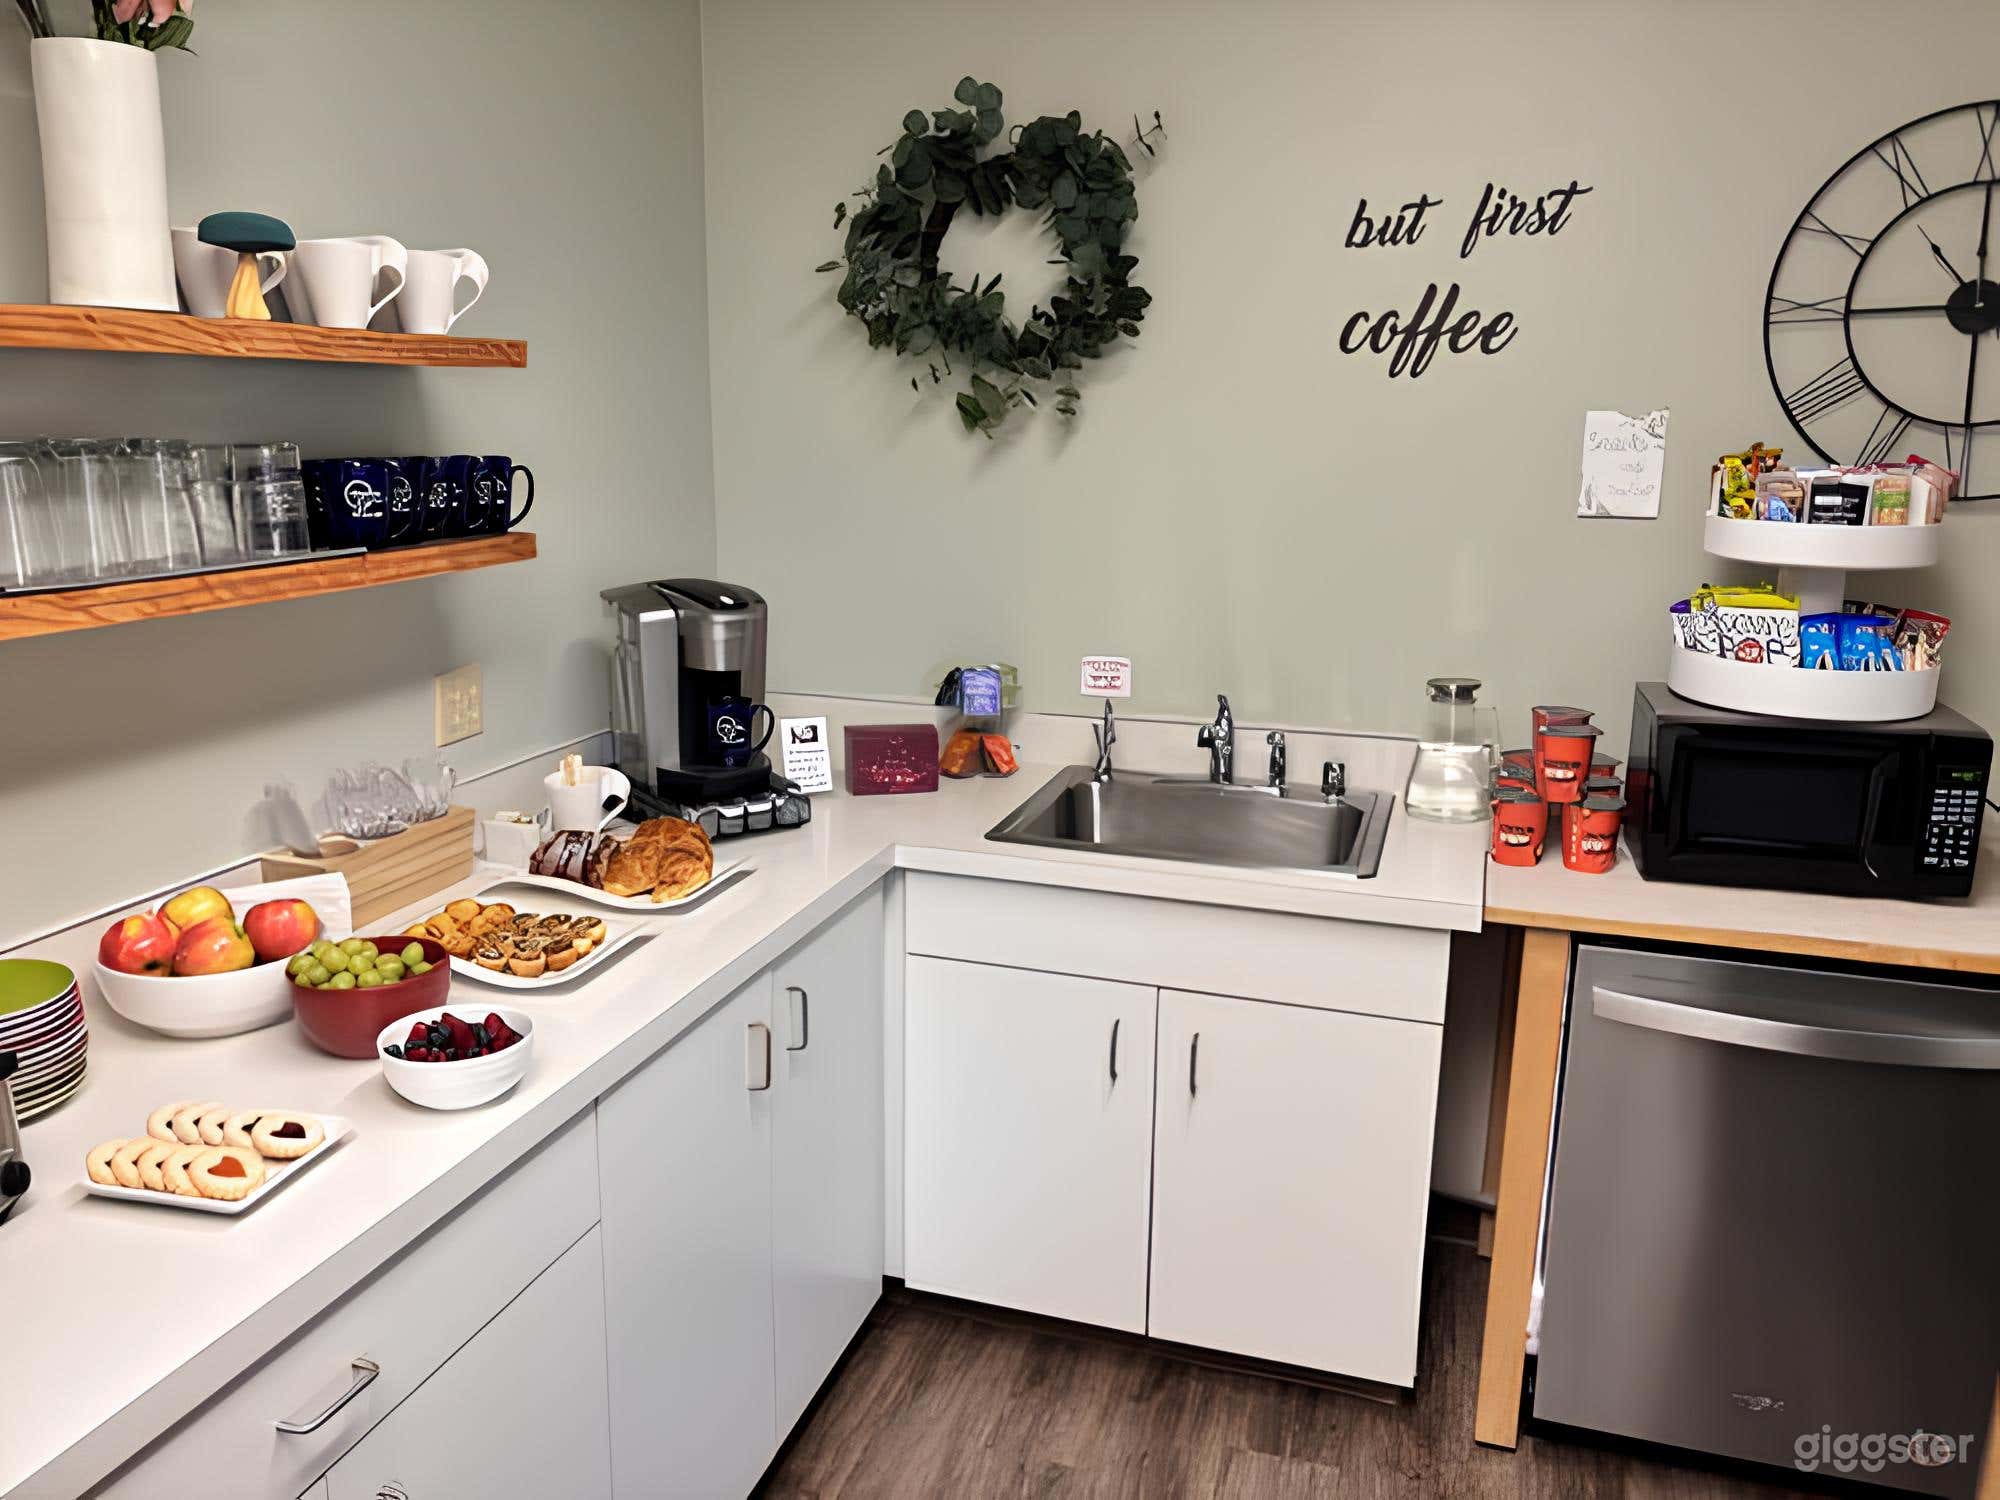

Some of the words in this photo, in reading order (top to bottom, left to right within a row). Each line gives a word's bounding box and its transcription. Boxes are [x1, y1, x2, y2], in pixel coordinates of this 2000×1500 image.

[1344, 194, 1443, 249] but
[1460, 180, 1593, 259] first
[1339, 283, 1518, 379] coffee
